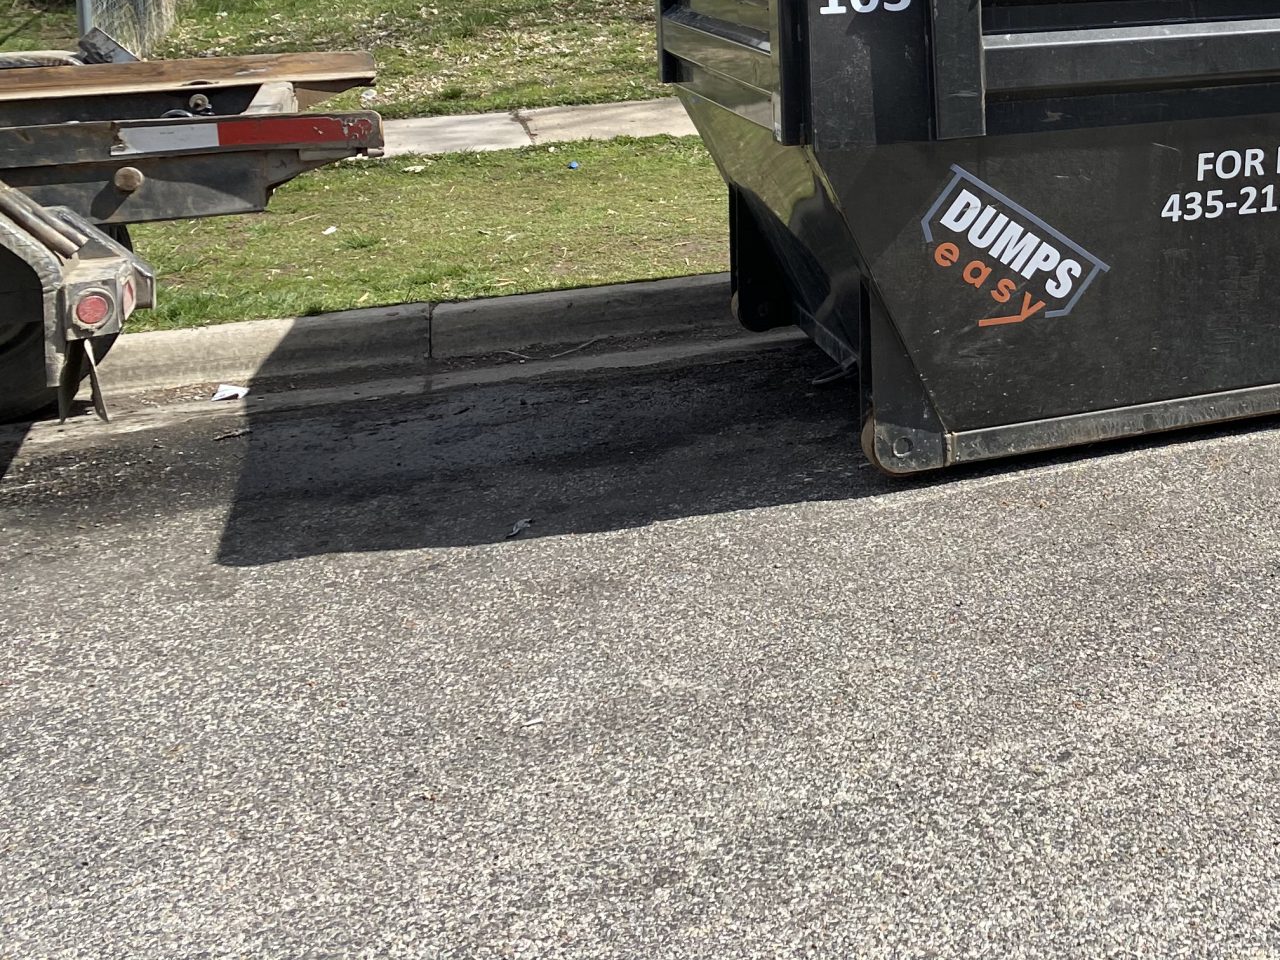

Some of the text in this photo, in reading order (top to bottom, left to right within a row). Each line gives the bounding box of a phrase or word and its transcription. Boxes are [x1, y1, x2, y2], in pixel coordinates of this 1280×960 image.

[1197, 148, 1265, 182] FOR
[933, 242, 1046, 327] easy
[939, 188, 1082, 299] DUMPS
